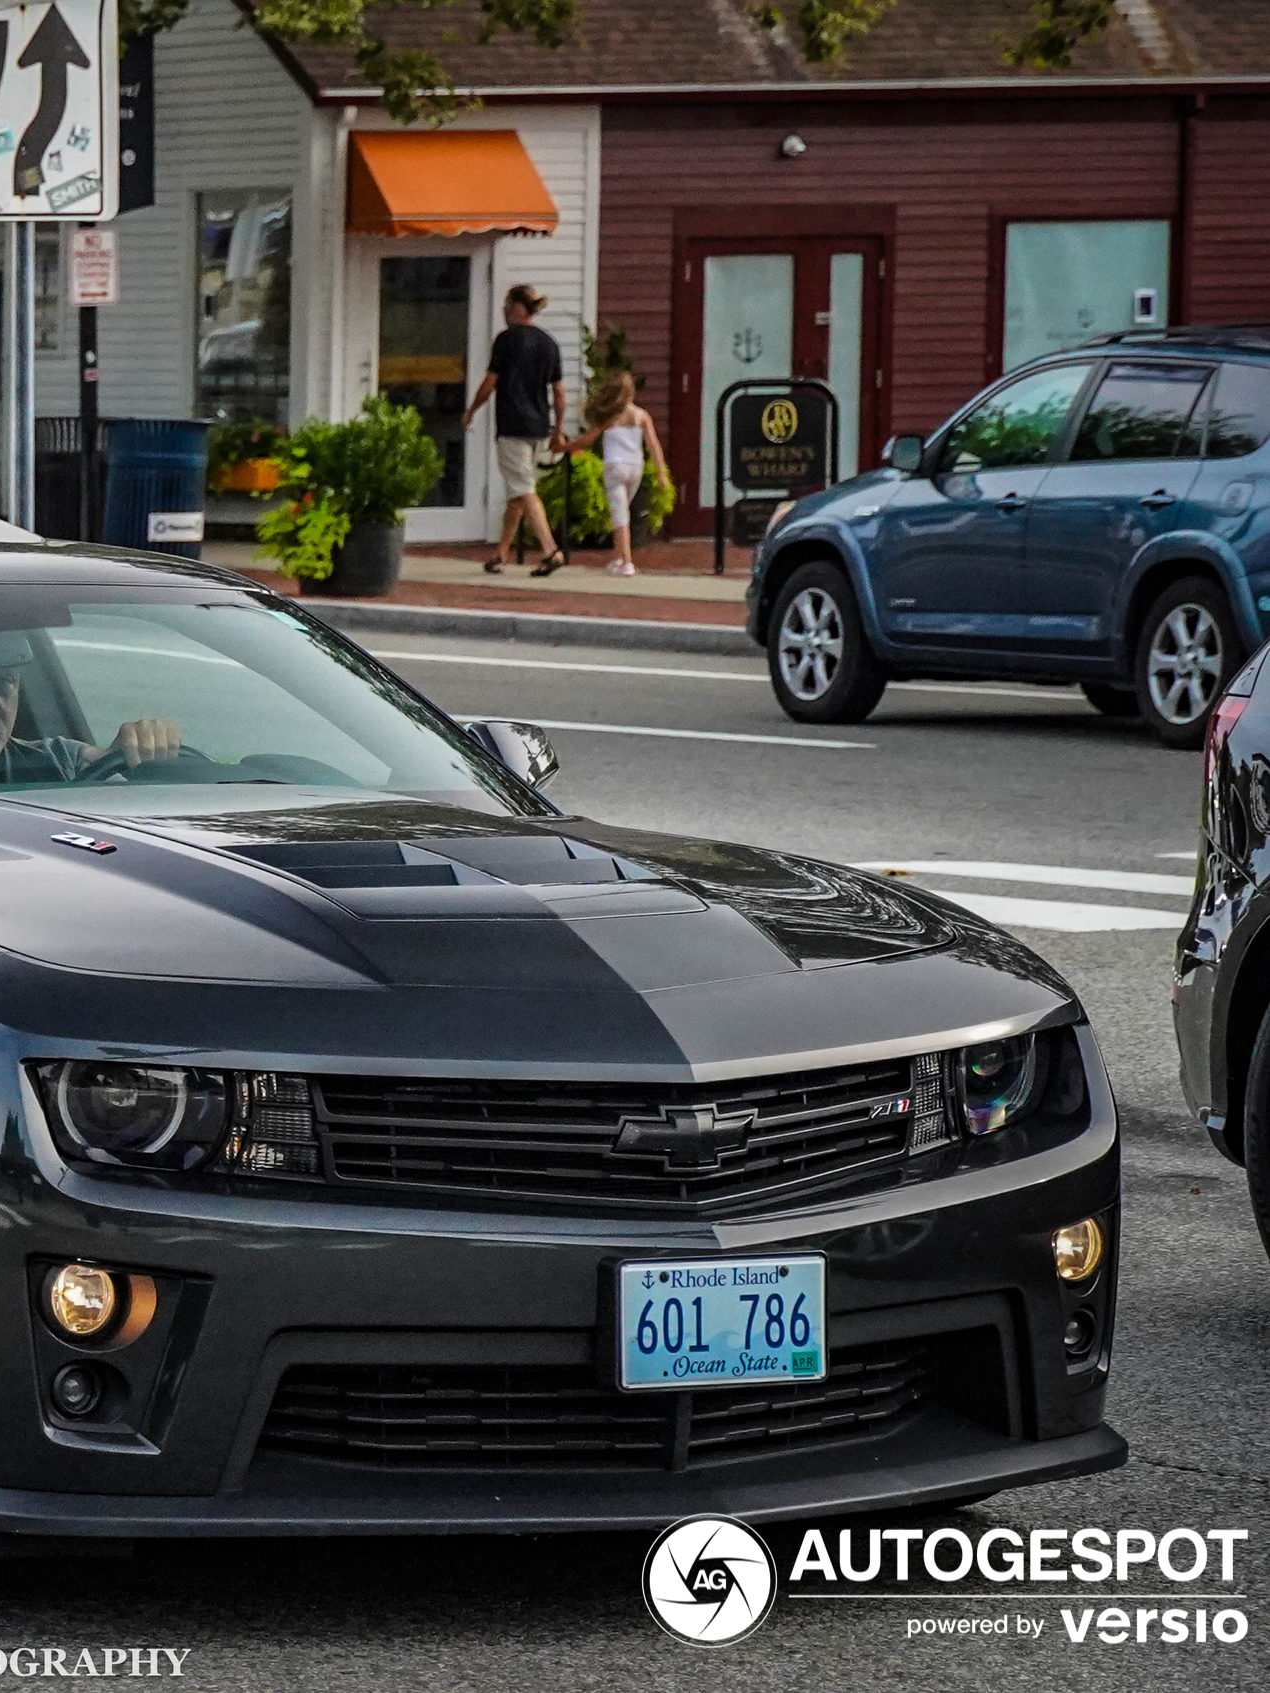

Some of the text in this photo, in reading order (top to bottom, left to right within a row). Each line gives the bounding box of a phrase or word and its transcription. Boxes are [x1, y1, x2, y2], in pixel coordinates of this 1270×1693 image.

[871, 1098, 910, 1118] ZL1
[670, 1265, 780, 1289] Rhode Island
[637, 1292, 810, 1355] 601 786
[673, 1352, 779, 1377] Ocean State
[792, 1357, 814, 1369] APR
